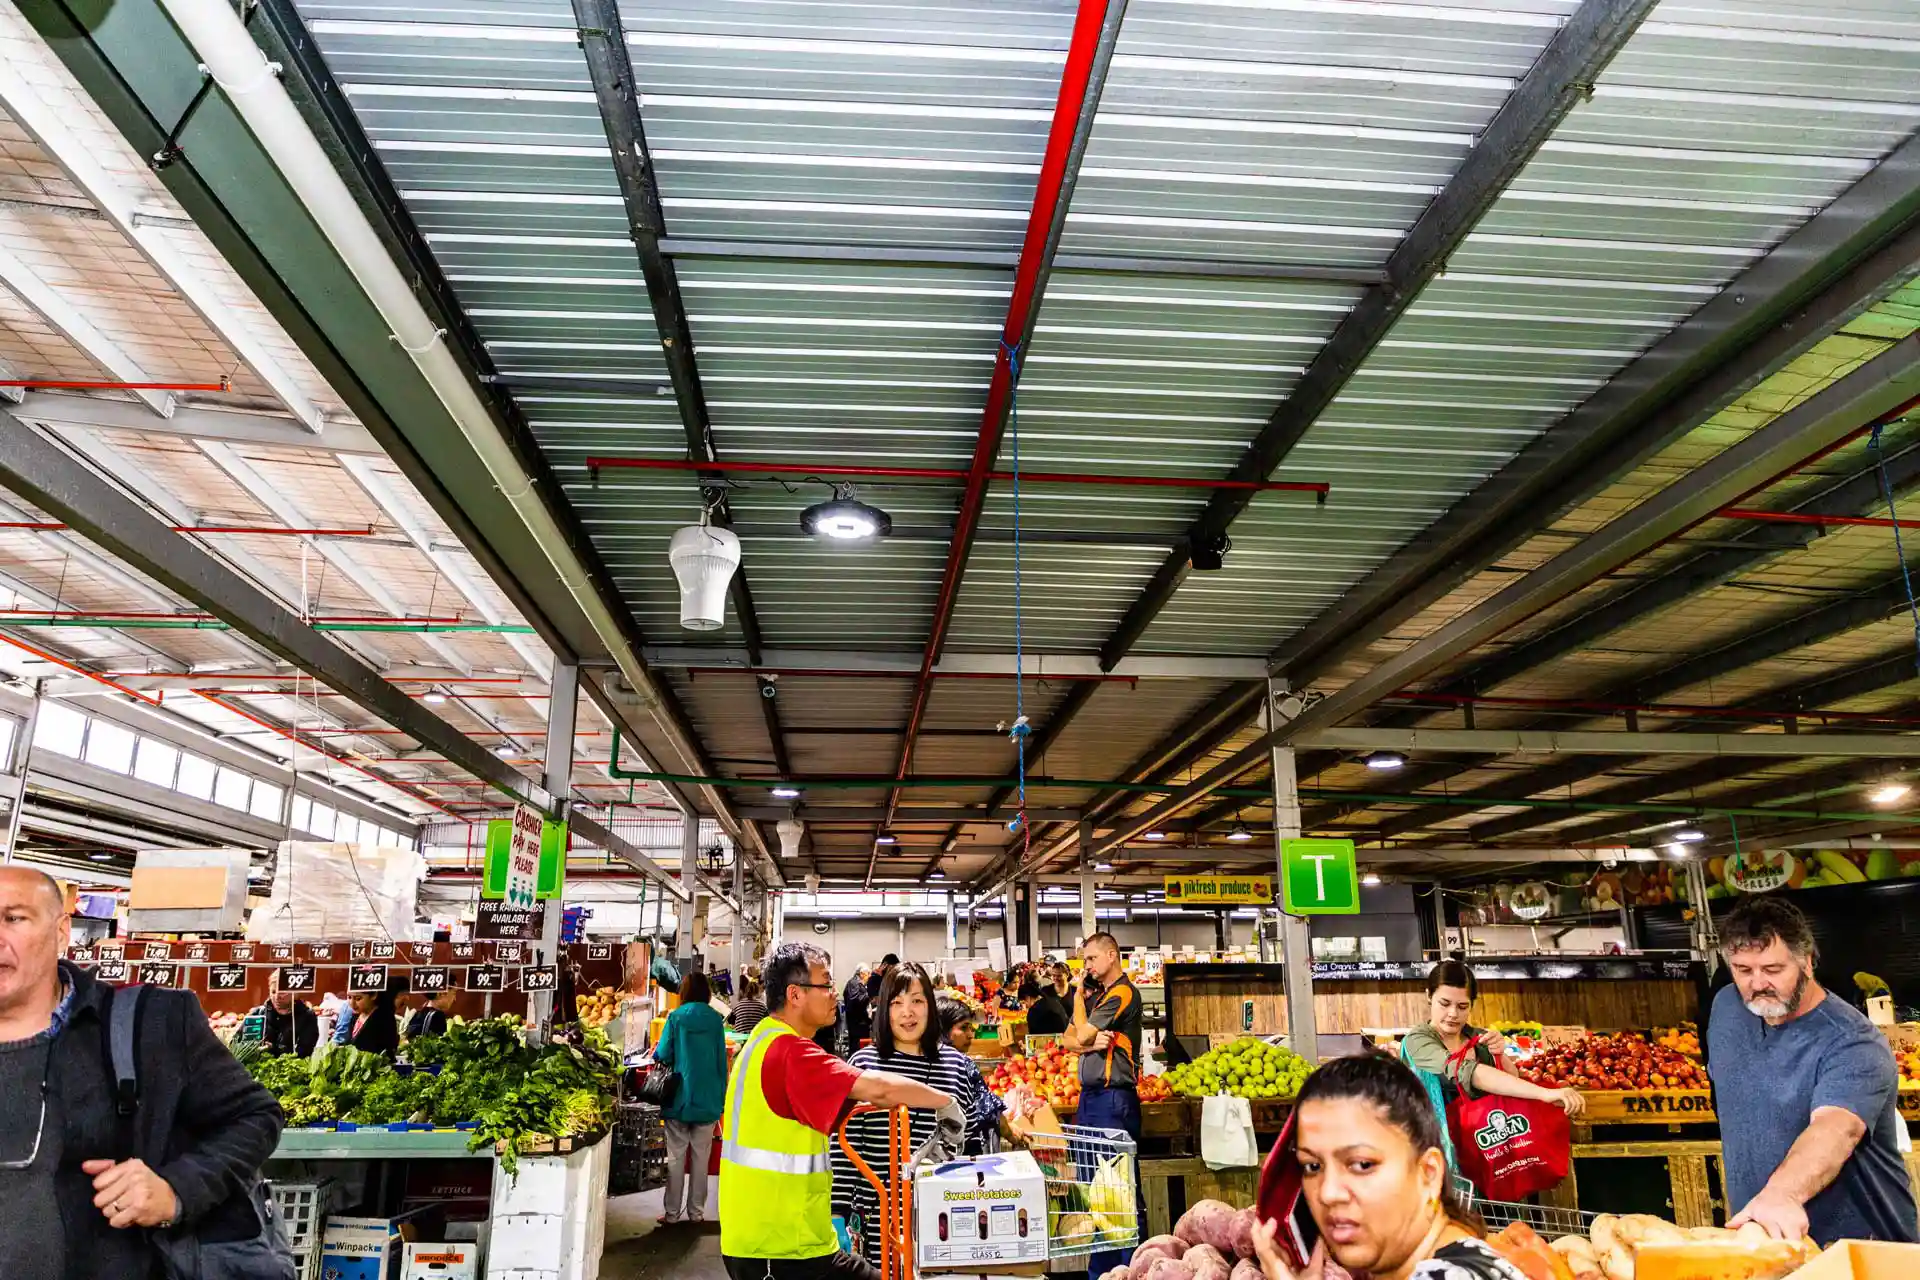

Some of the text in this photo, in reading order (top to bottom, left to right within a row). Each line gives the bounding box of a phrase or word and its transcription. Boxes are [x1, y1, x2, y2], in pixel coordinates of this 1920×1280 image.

[512, 835, 539, 858] PAY HERE
[514, 855, 534, 876] PLEASE
[1301, 854, 1336, 901] T
[1184, 879, 1251, 899] pikfresh produce
[480, 902, 498, 912] FREE
[490, 914, 530, 923] AVAILABLE
[500, 925, 519, 935] HERE
[432, 1186, 473, 1194] LETTUCE
[943, 1188, 1022, 1202] Sweet Potatoes
[335, 1240, 375, 1253] Winpack
[971, 1251, 993, 1259] CLASS
